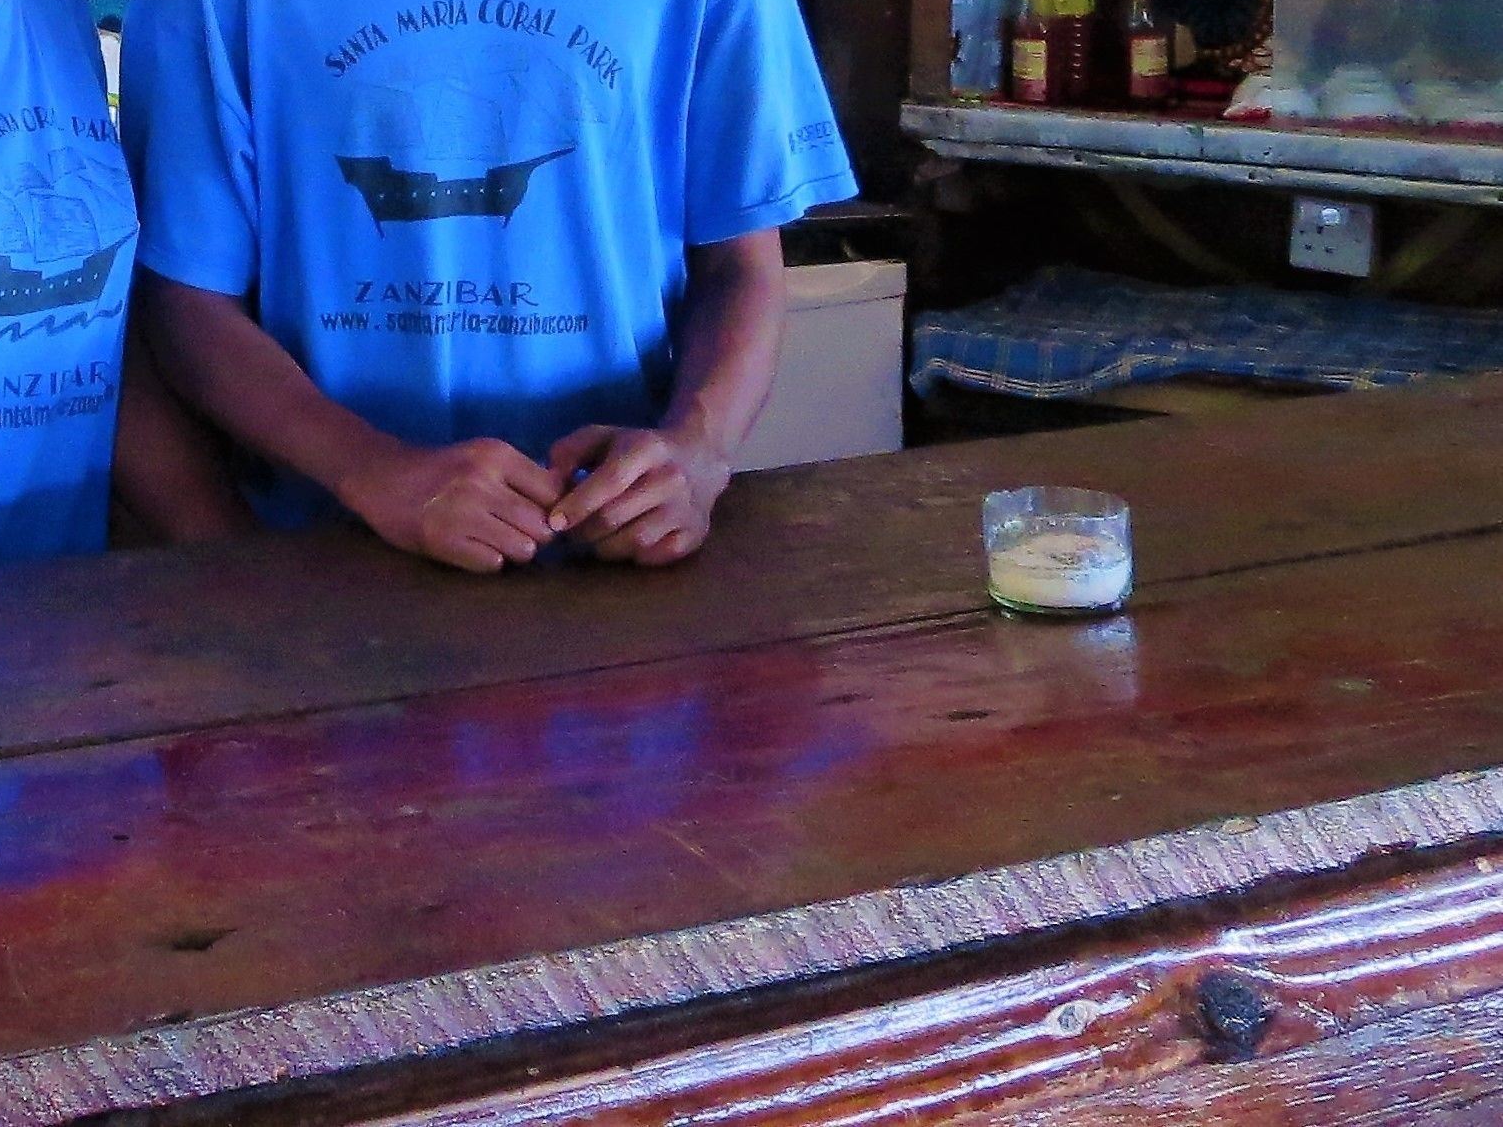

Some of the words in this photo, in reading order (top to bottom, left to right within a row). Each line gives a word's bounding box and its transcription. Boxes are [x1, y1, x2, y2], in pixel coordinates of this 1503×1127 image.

[325, 23, 389, 78] SANTA
[566, 25, 624, 90] PARK
[354, 280, 540, 307] ZANZIBAR
